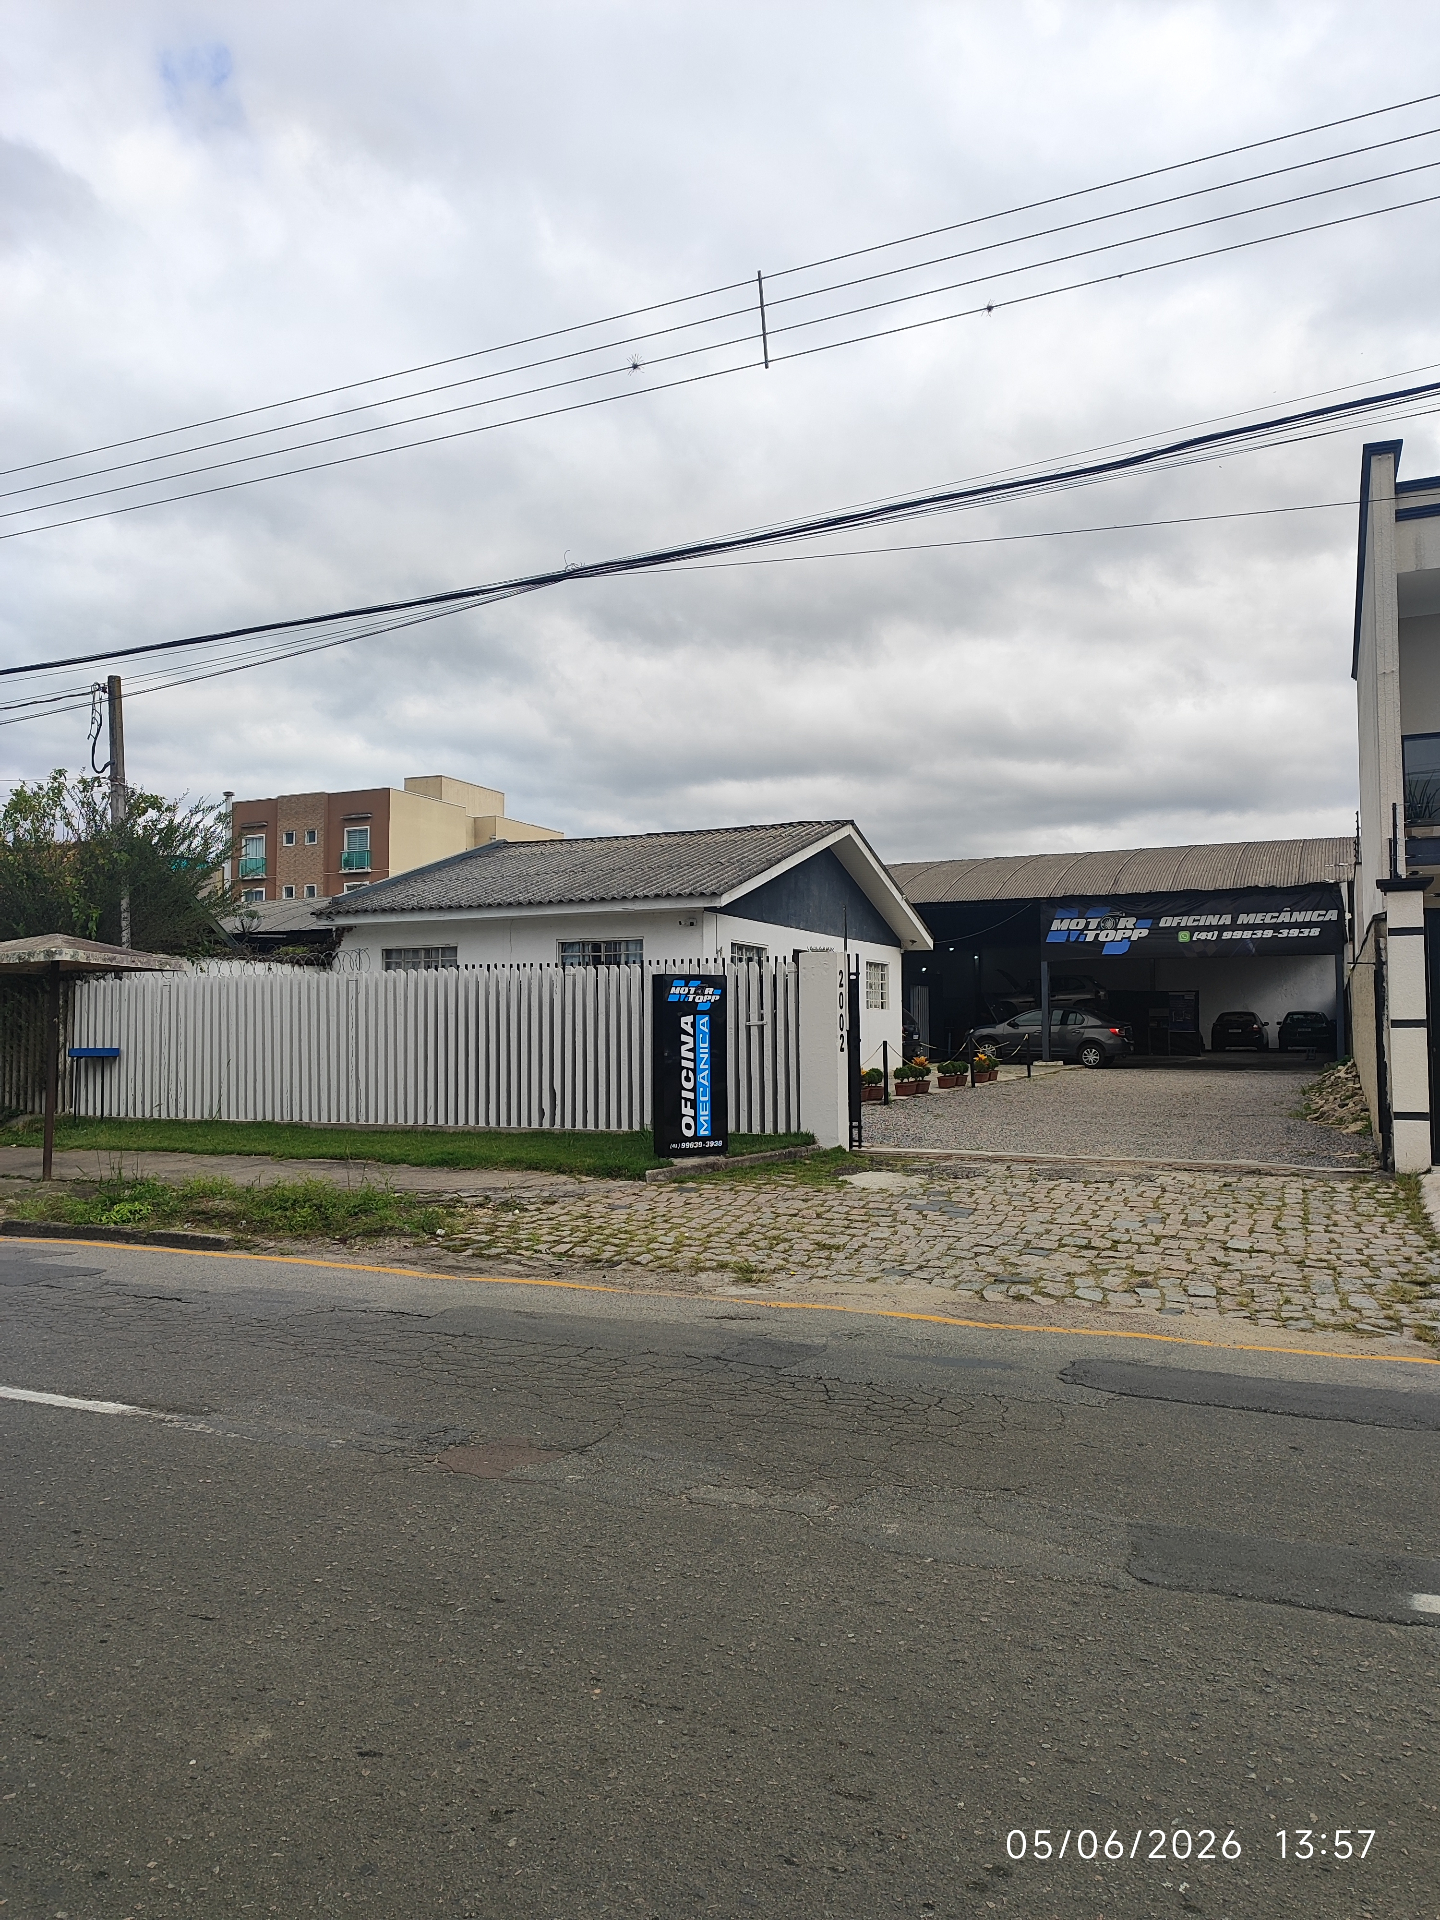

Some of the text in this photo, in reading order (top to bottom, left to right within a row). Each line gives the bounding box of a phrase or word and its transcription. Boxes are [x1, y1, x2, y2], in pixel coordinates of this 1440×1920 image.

[1159, 908, 1338, 927] OFICINA MECÂNICA
[1084, 928, 1149, 942] TOPP
[1192, 930, 1218, 942] (41)
[687, 994, 720, 1003] TOPP
[680, 1015, 695, 1138] OFICINA
[698, 1016, 709, 1135] MECÂNICA
